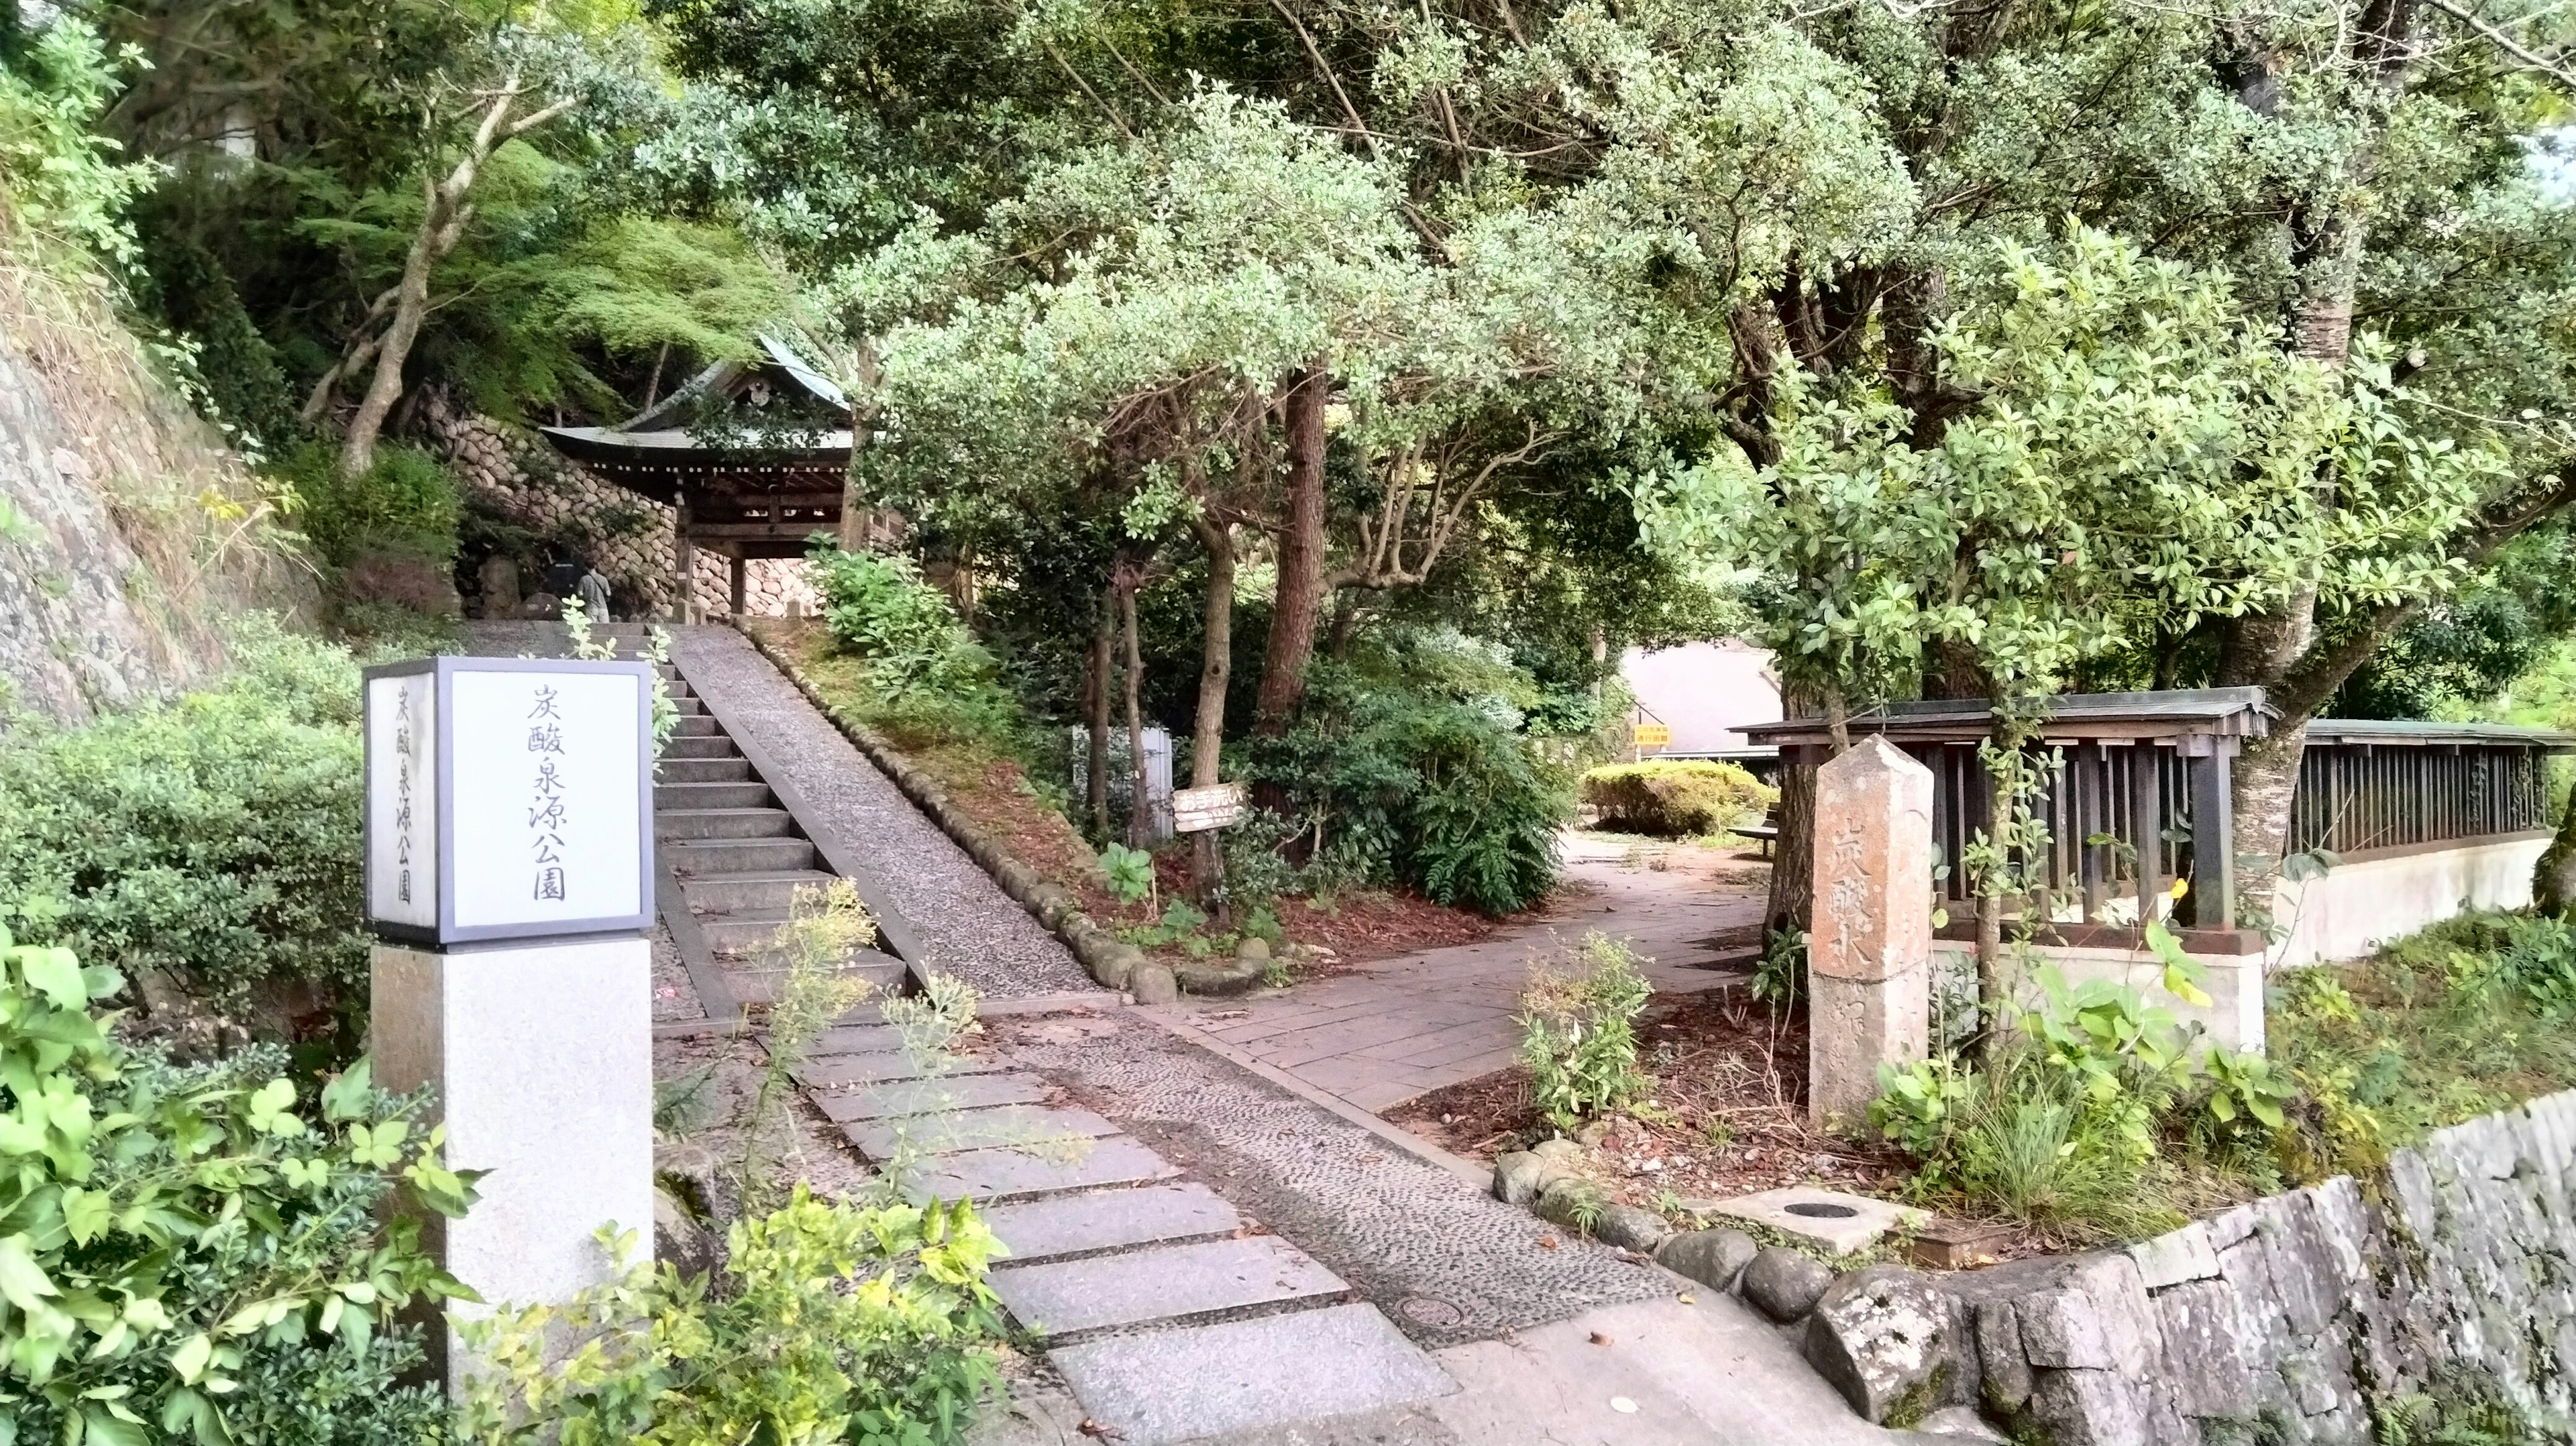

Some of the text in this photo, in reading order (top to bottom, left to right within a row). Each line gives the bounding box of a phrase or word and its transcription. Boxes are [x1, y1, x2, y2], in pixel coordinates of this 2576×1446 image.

[395, 686, 411, 906] 炭酸泉源公園
[527, 683, 568, 902] 炭酸泉源公園
[1180, 788, 1243, 812] お手洗い
